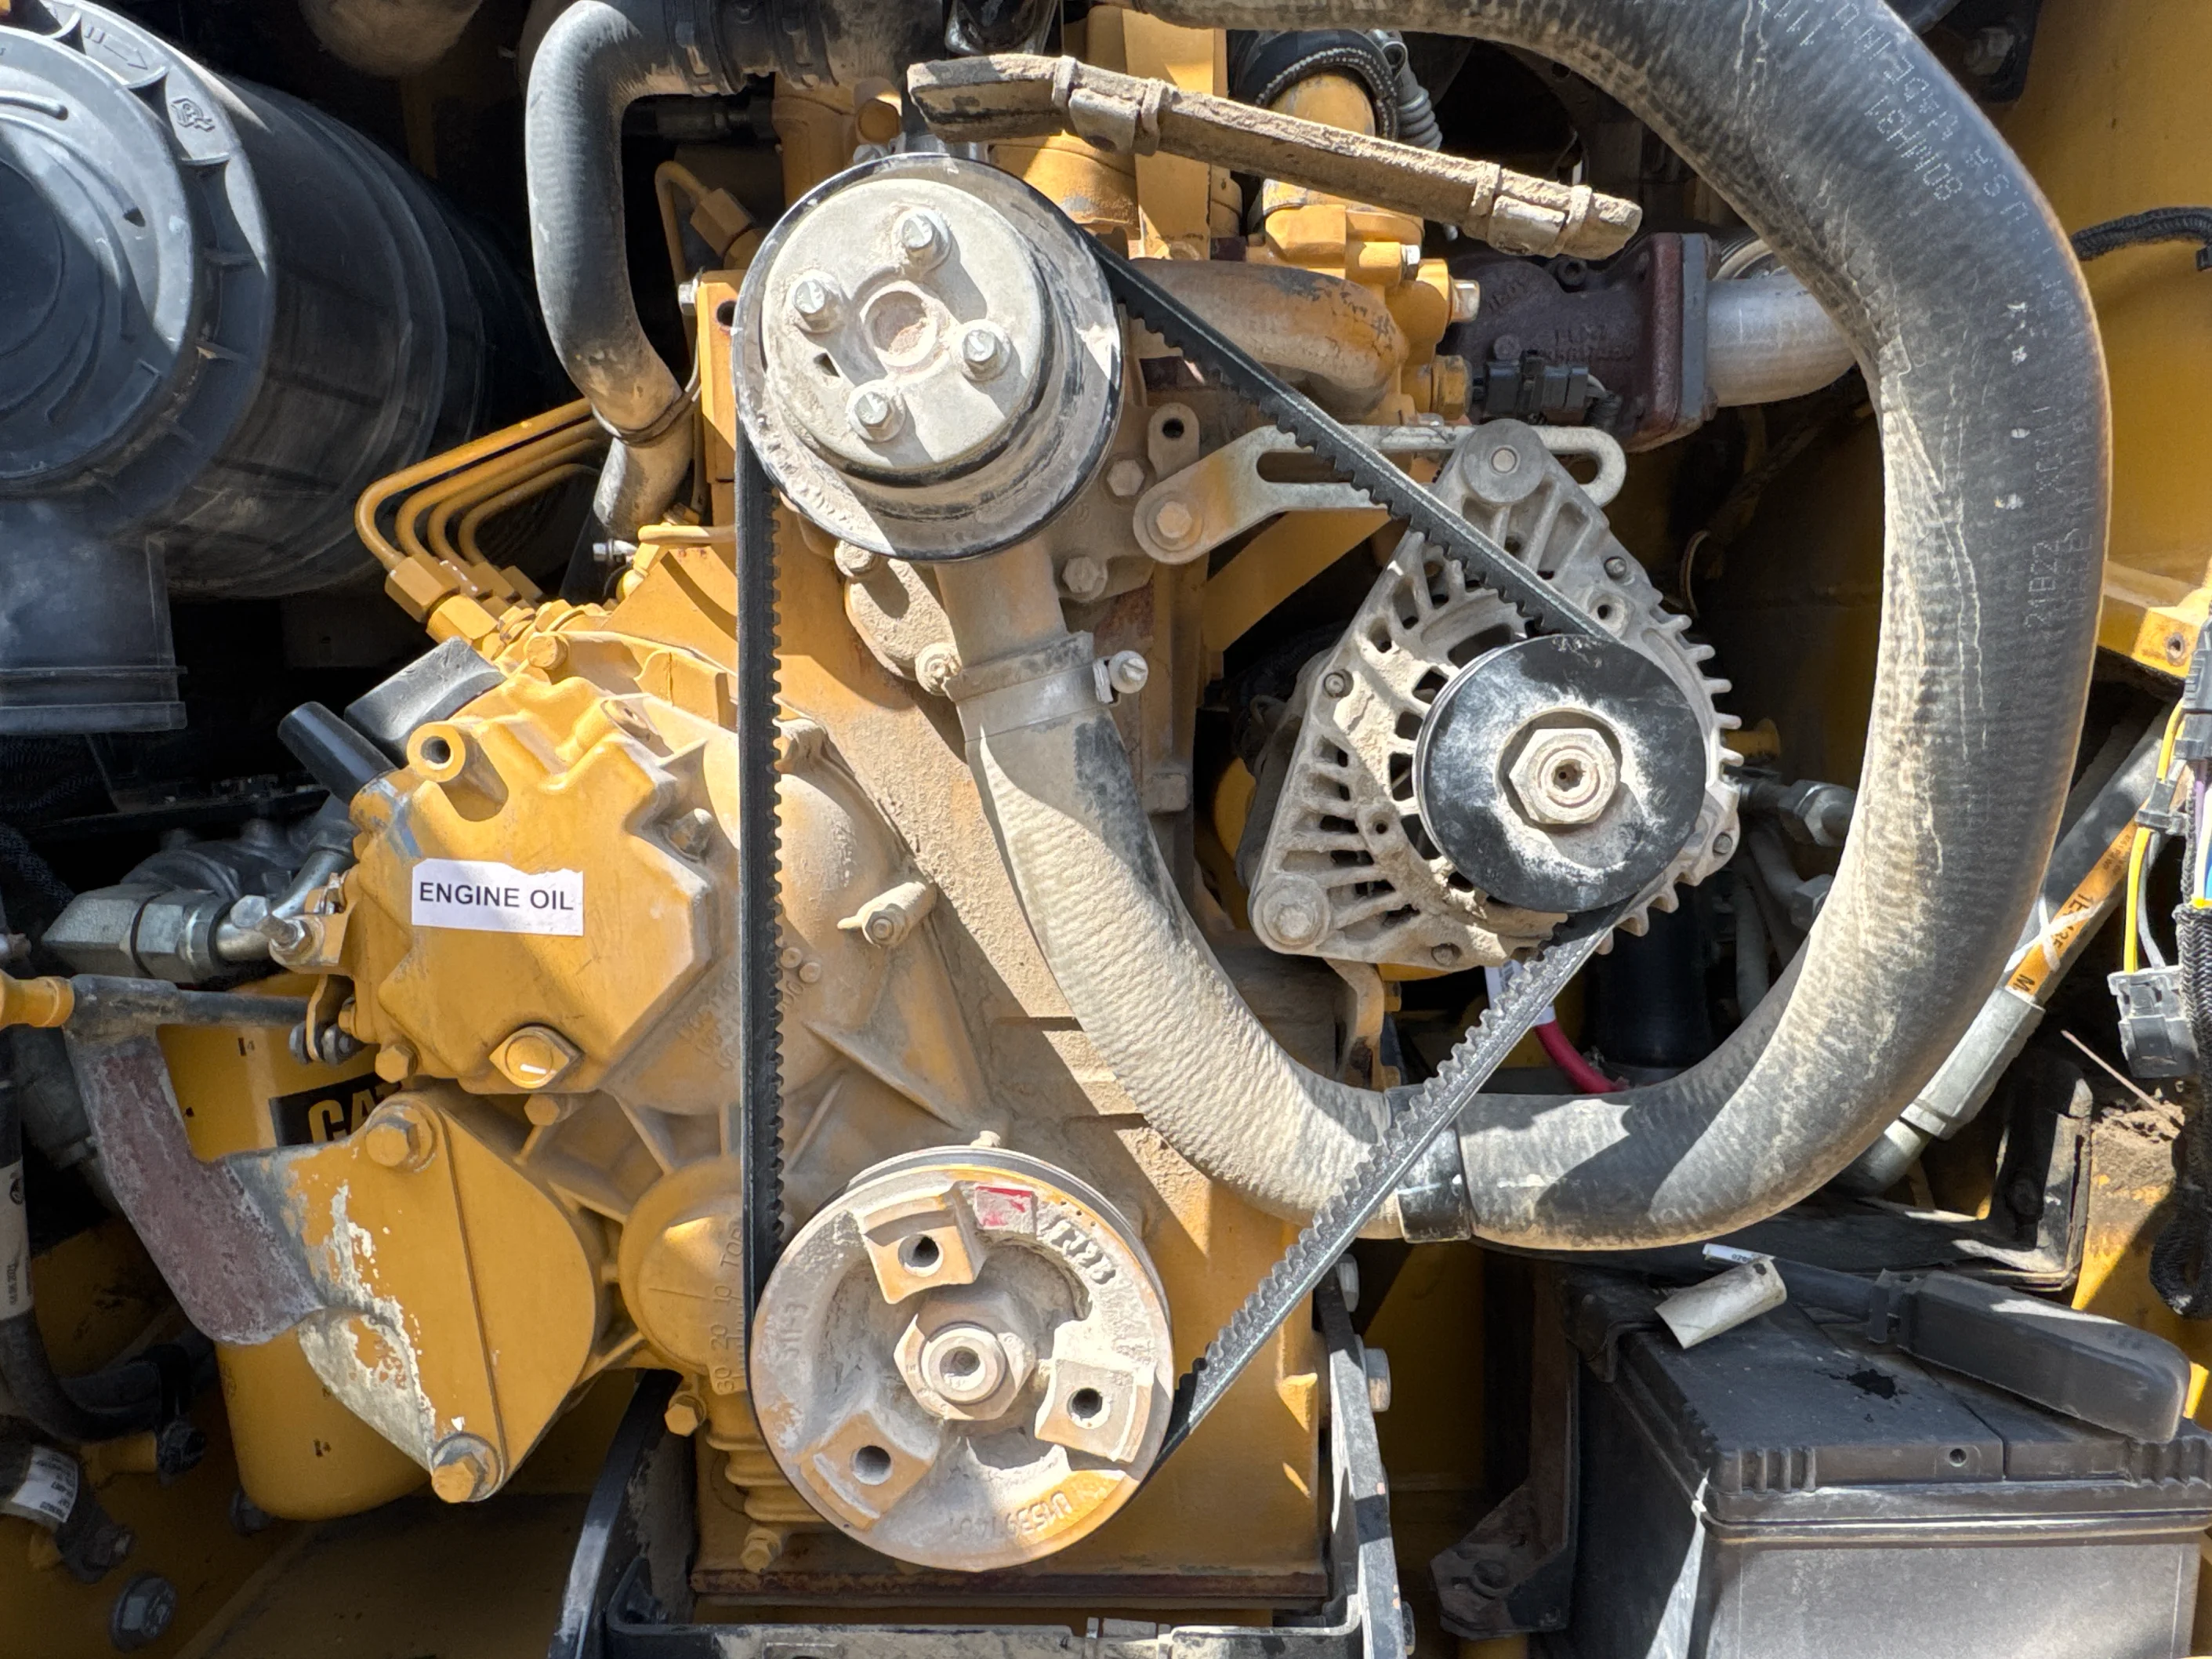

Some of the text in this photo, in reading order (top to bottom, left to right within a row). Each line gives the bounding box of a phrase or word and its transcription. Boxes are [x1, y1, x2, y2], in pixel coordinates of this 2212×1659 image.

[419, 881, 574, 911] ENGINE OIL
[713, 1285, 732, 1306] 10
[710, 1323, 729, 1352] 20
